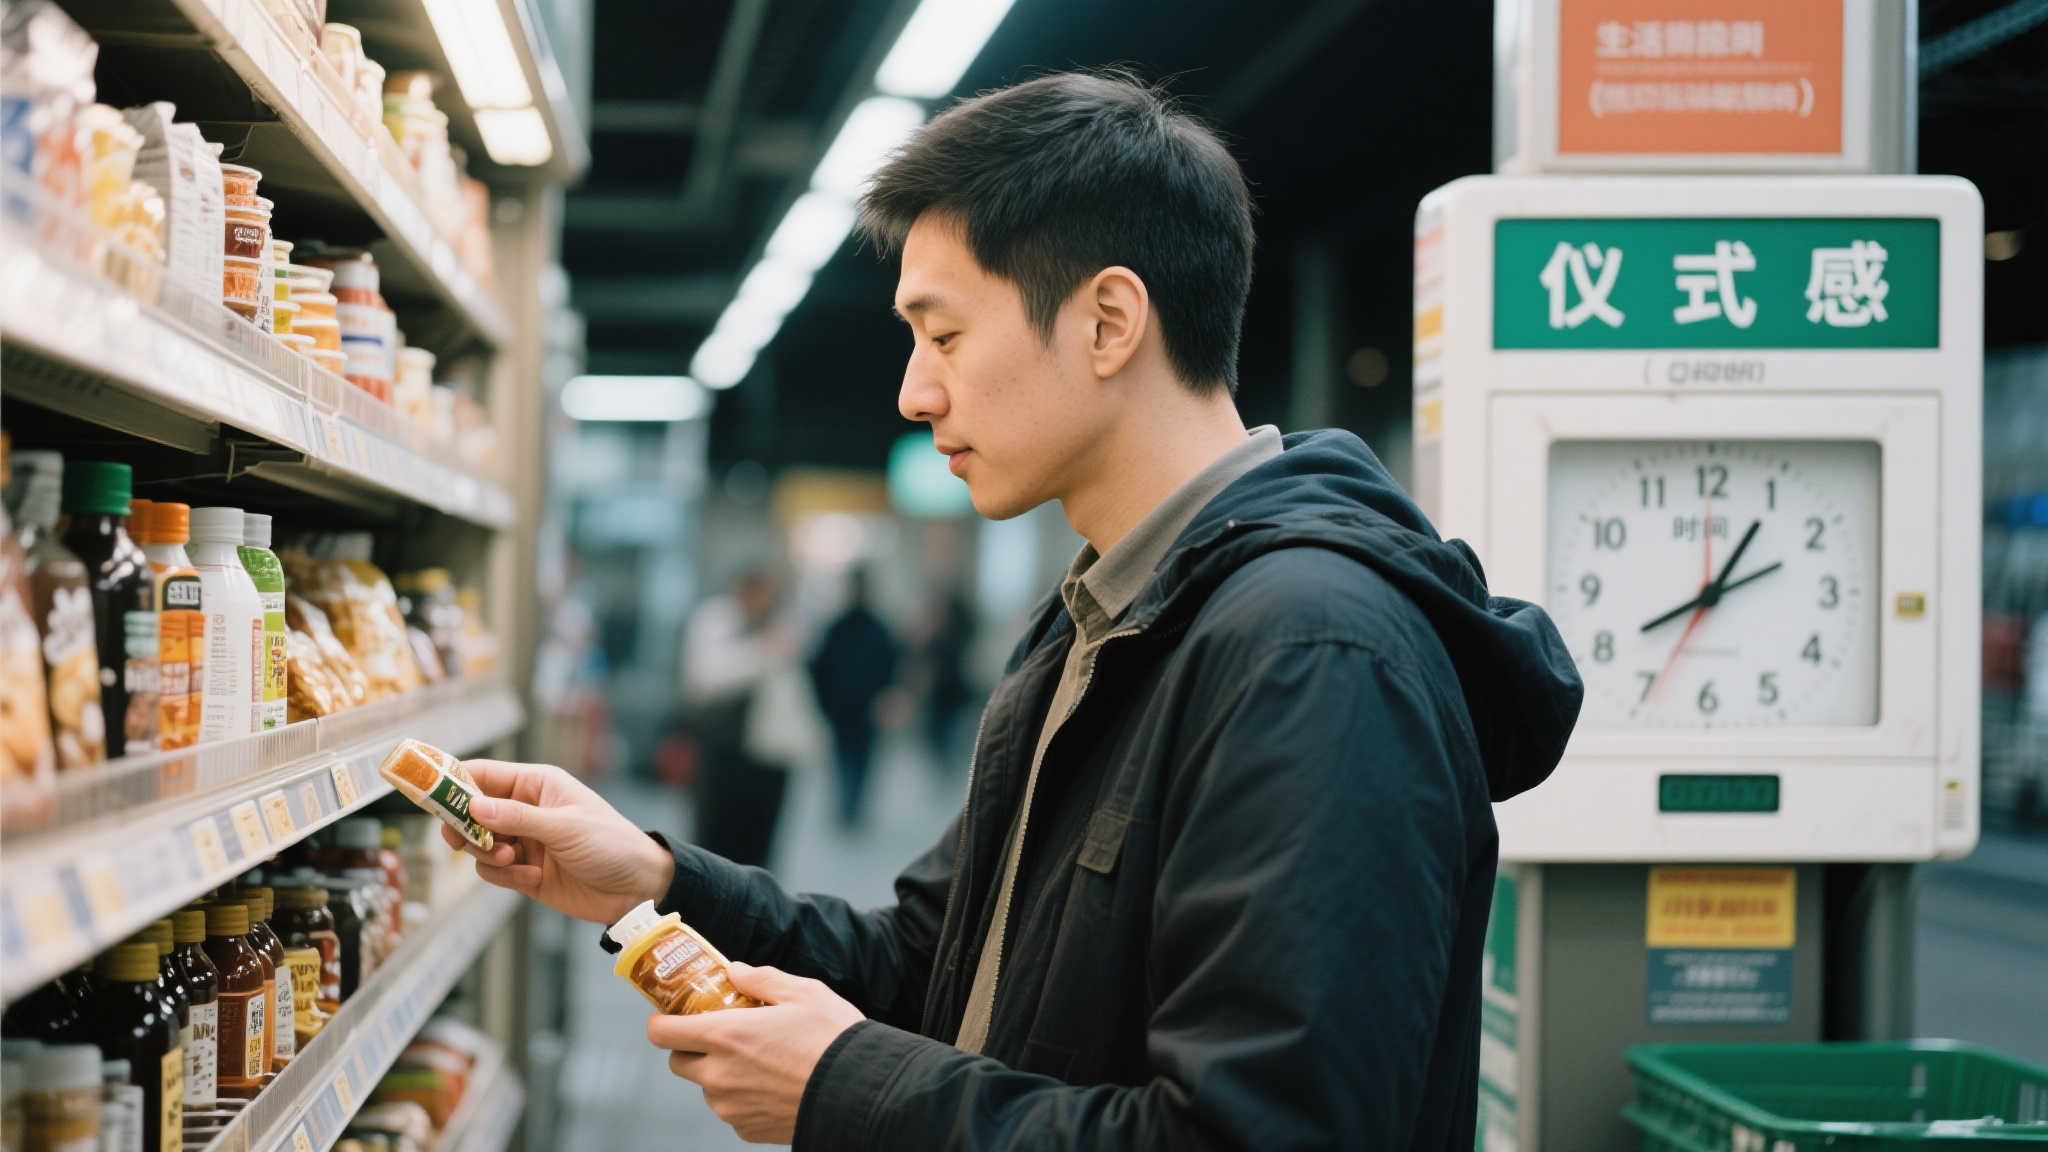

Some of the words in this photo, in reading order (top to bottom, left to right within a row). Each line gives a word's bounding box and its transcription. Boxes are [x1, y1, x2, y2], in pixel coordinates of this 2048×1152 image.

[1540, 240, 1890, 329] 仪式感
[1639, 475, 1667, 509] 11
[1695, 463, 1729, 499] 12
[1765, 476, 1778, 510] 1
[1592, 516, 1627, 551] 10
[1804, 516, 1826, 552] 2
[1579, 574, 1603, 606] 9
[1818, 575, 1842, 610] 3
[1591, 630, 1616, 664] 8
[1800, 634, 1824, 666] 4
[1636, 670, 1660, 704] 7
[1696, 681, 1720, 715] 6
[1757, 671, 1781, 706] 5
